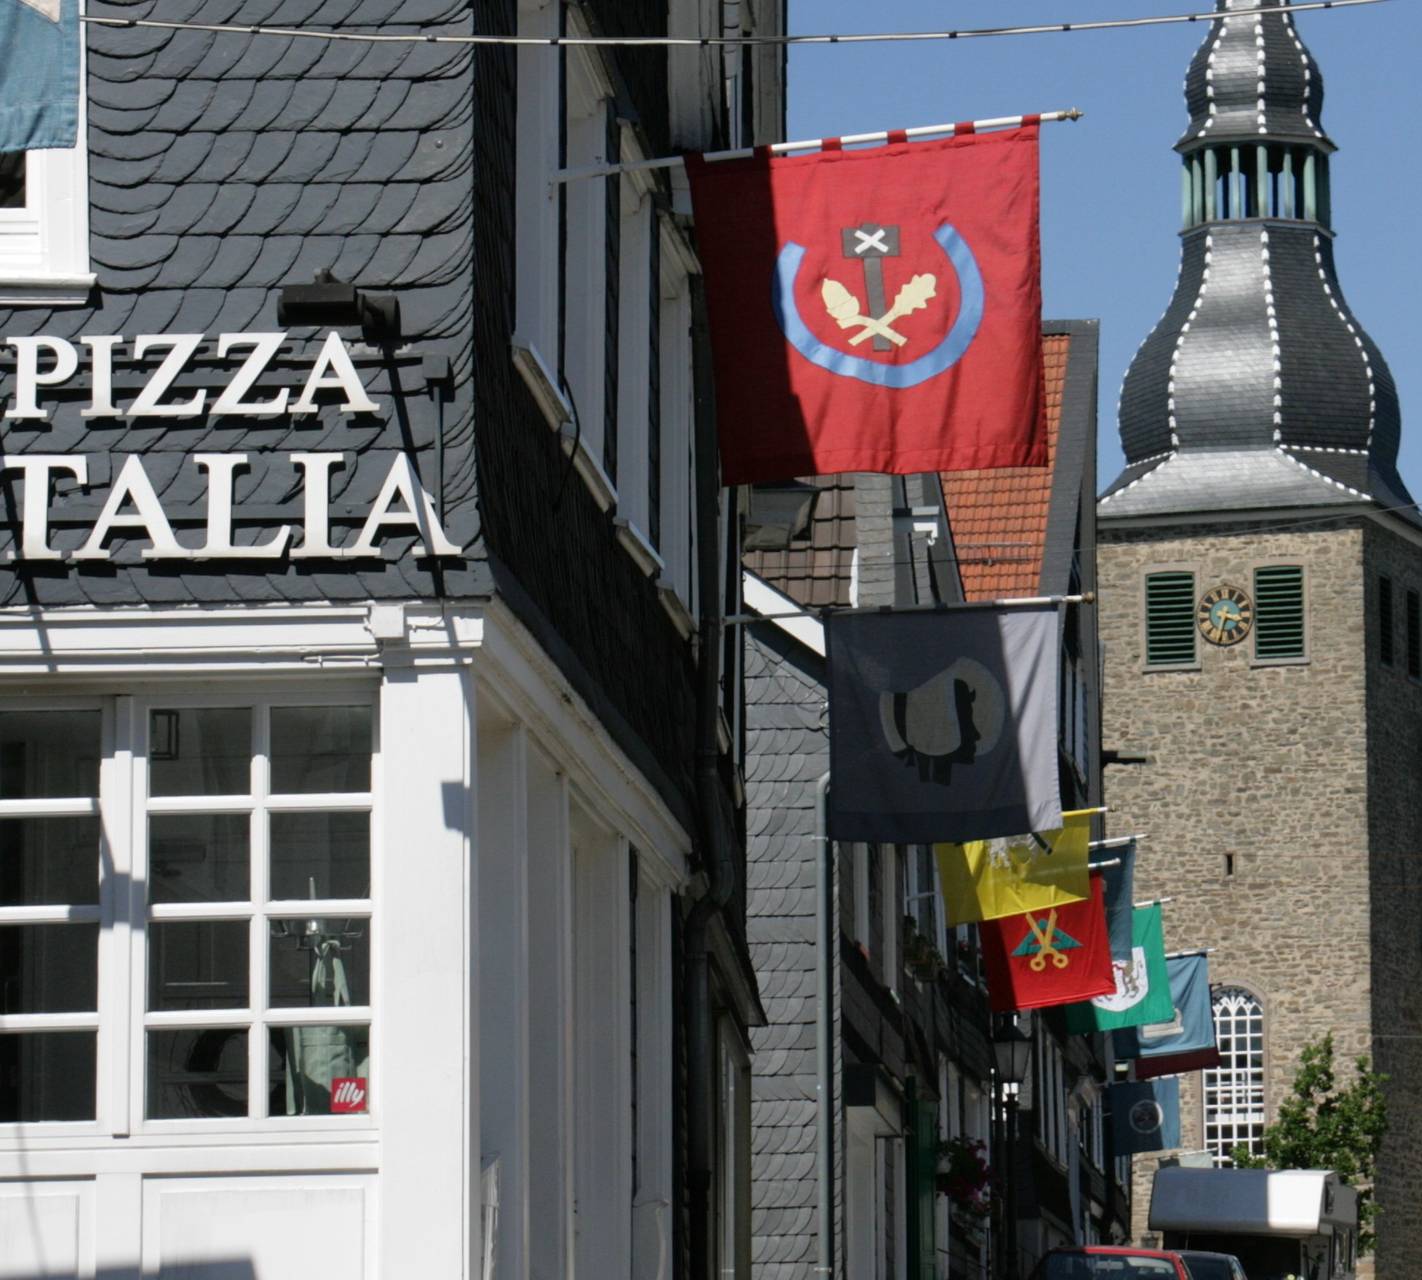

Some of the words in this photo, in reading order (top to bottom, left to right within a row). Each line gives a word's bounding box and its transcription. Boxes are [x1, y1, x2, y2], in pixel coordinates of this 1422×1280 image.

[4, 331, 380, 419] PIZZA
[3, 451, 463, 560] TALIA
[334, 1081, 365, 1108] illy
